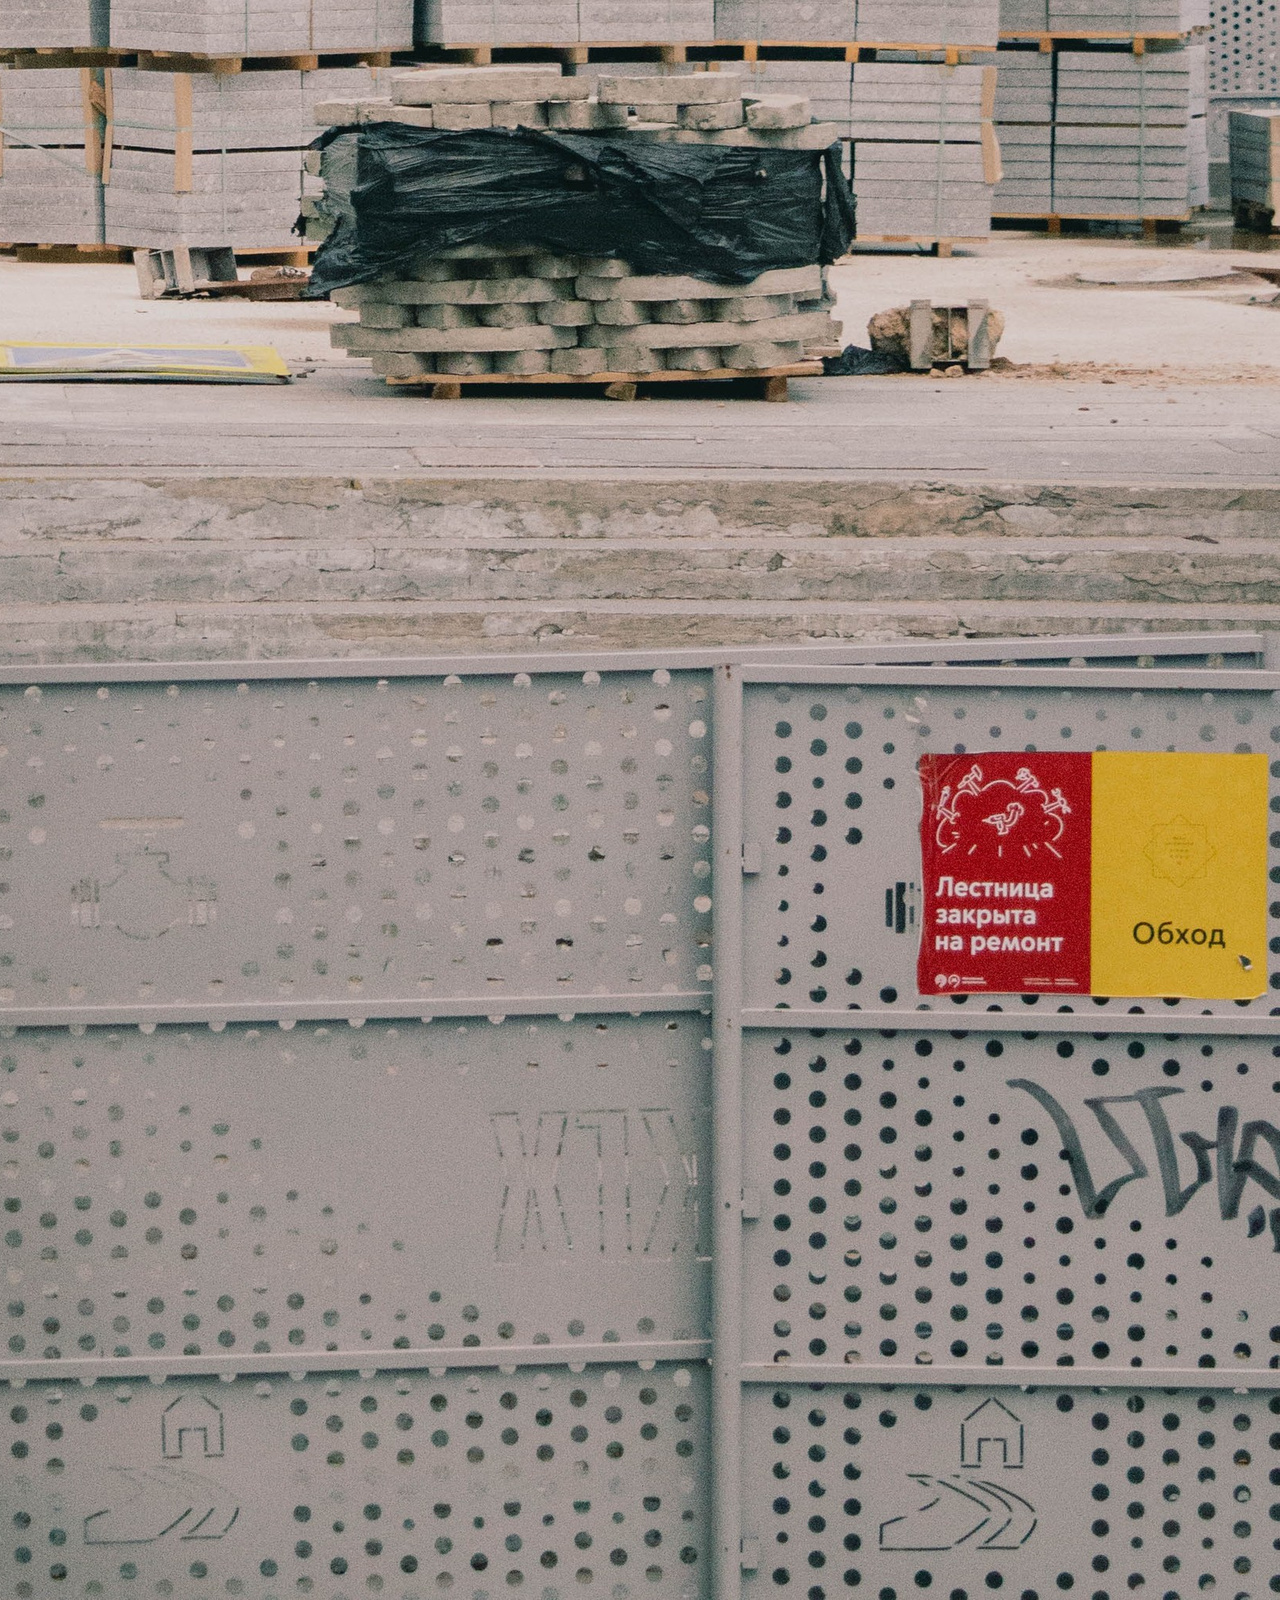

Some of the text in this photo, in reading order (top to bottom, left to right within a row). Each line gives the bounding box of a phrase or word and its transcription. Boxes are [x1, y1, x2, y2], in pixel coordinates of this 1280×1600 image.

[935, 876, 1054, 900] Лестница
[935, 908, 1037, 927] закрыта
[935, 935, 1064, 955] на ремонт
[1132, 921, 1226, 949] Обход
